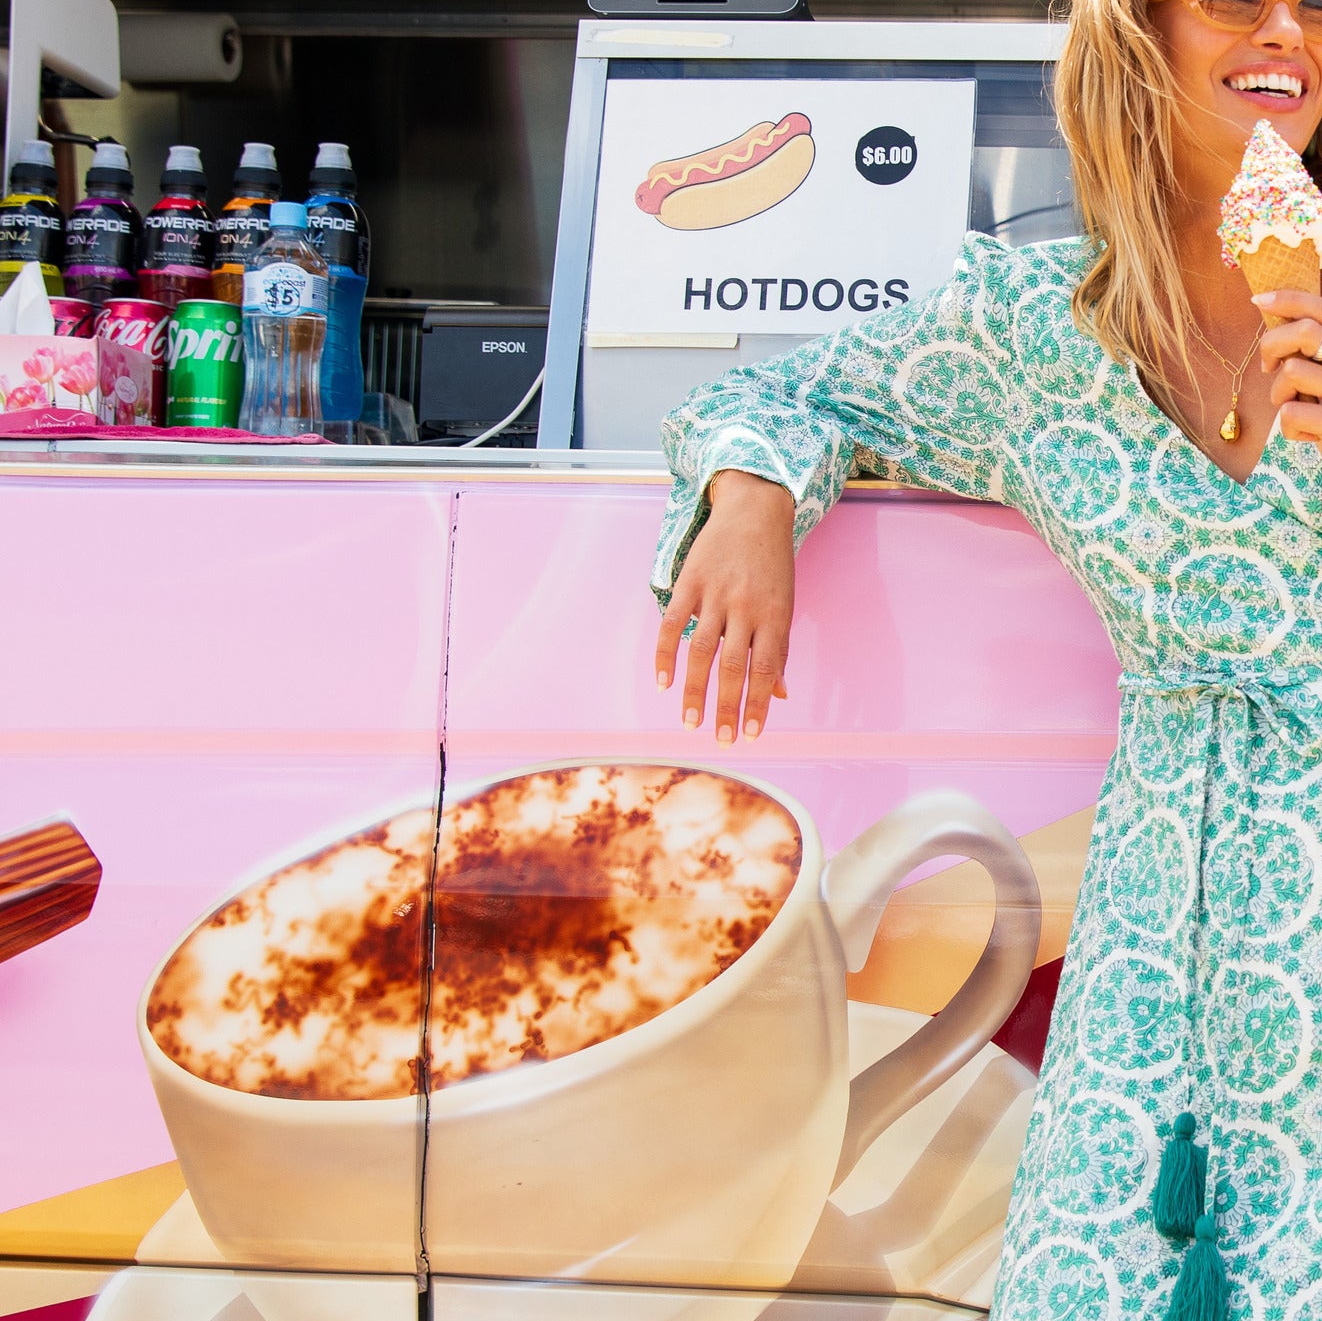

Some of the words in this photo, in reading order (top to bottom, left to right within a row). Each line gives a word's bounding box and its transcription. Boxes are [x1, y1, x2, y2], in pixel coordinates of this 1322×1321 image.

[862, 146, 912, 165] $6.00
[684, 278, 909, 311] HOTDOGS
[482, 342, 525, 353] EPSON
